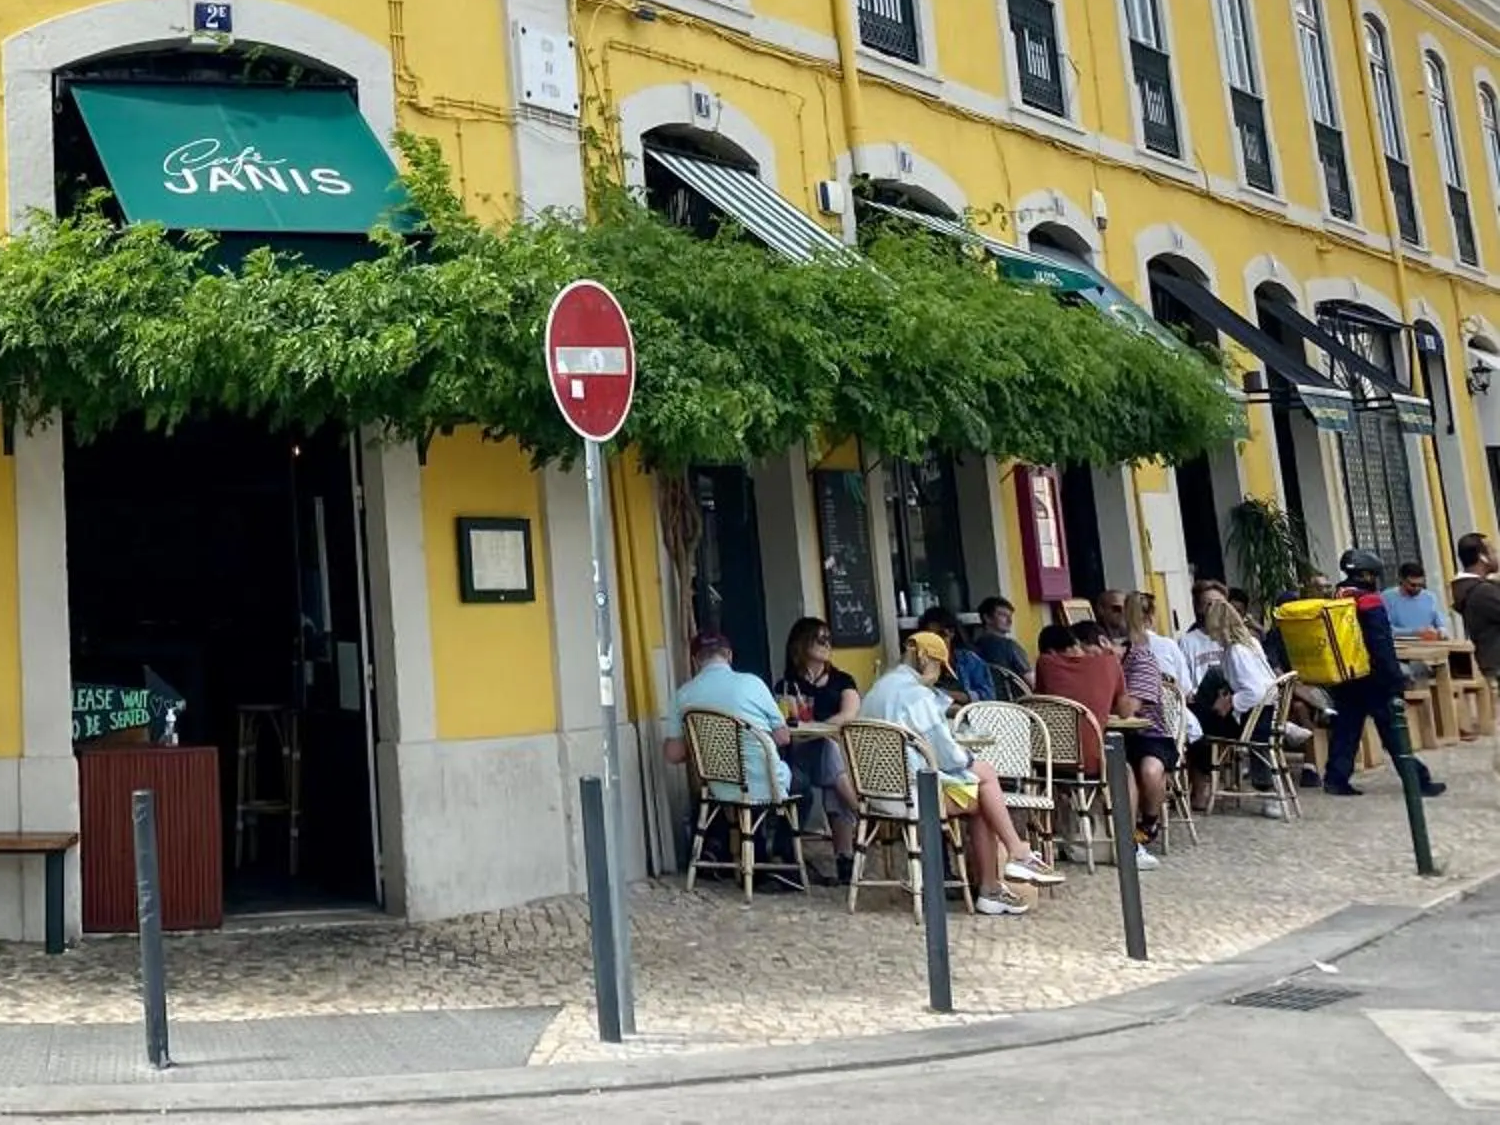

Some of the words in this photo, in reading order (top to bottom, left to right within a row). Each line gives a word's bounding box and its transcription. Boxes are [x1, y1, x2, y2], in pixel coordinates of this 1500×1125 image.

[164, 165, 352, 194] JANIS
[72, 688, 113, 711] LEASE
[120, 689, 149, 709] WAIT
[85, 715, 102, 737] BE
[109, 709, 151, 731] SEATED
